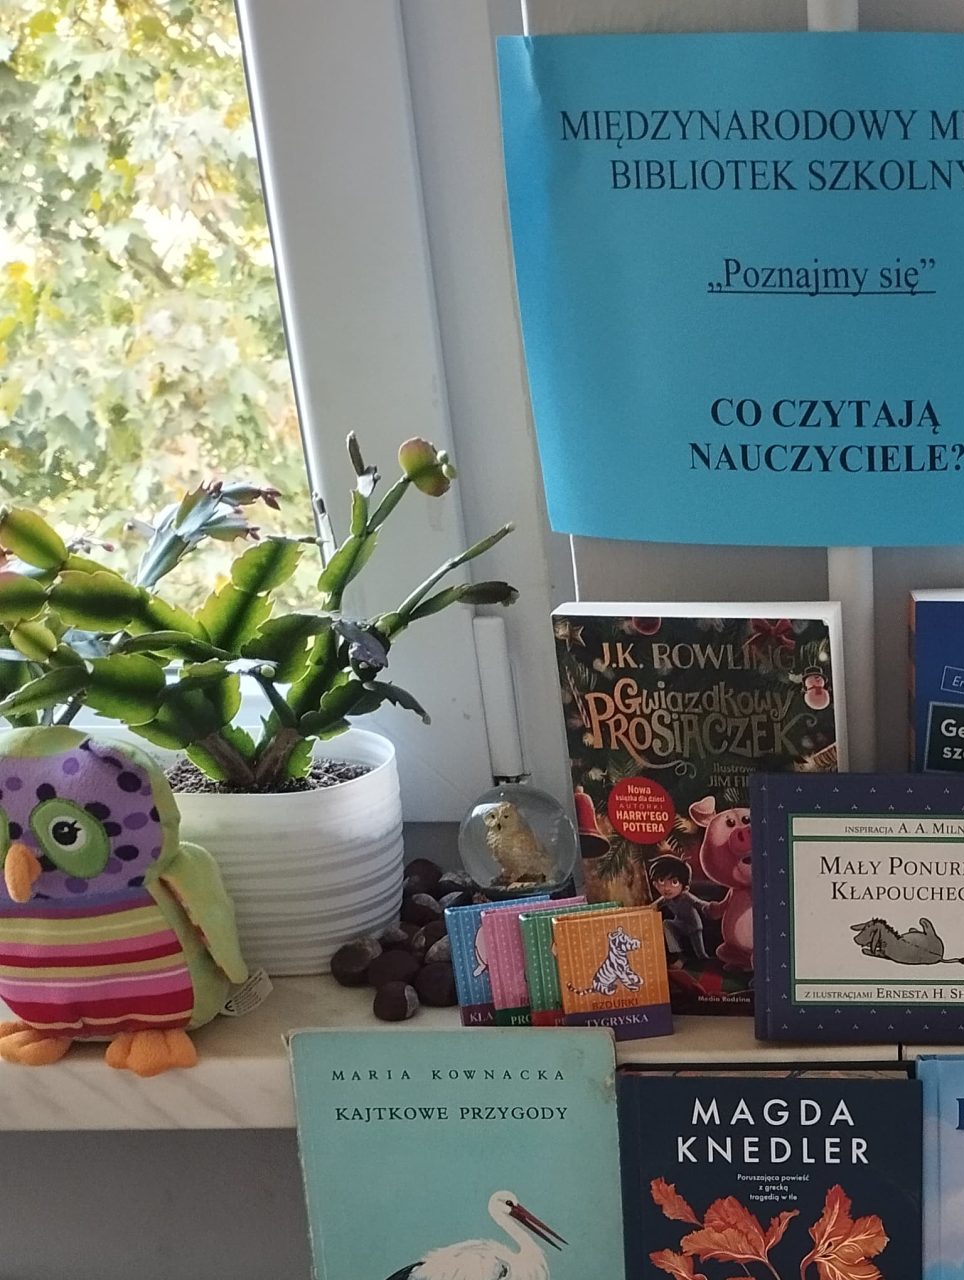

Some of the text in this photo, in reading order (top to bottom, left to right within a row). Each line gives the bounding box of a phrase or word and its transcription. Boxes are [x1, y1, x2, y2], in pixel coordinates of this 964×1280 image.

[560, 110, 917, 149] MIĘDZYNARODOWY
[611, 160, 798, 191] BIBLIOTEK
[711, 399, 941, 435] CO CZYTAJĄ
[601, 642, 796, 670] J.K. ROWLING
[614, 678, 794, 718] Gwiazdkowy
[628, 785, 651, 794] Nowa
[616, 810, 668, 821] HARRY'EGO
[623, 822, 664, 832] POTTERA
[845, 825, 894, 834] INSPIRACJA
[585, 1014, 649, 1027] TYGRYSKA
[332, 1070, 564, 1081] MARIA KOWNACKA
[336, 1107, 568, 1122] KAJTKOWE PRZYGODY
[691, 1098, 854, 1126] MAGDA
[677, 1137, 868, 1164] KNEDLER
[781, 1174, 809, 1182] powieść
